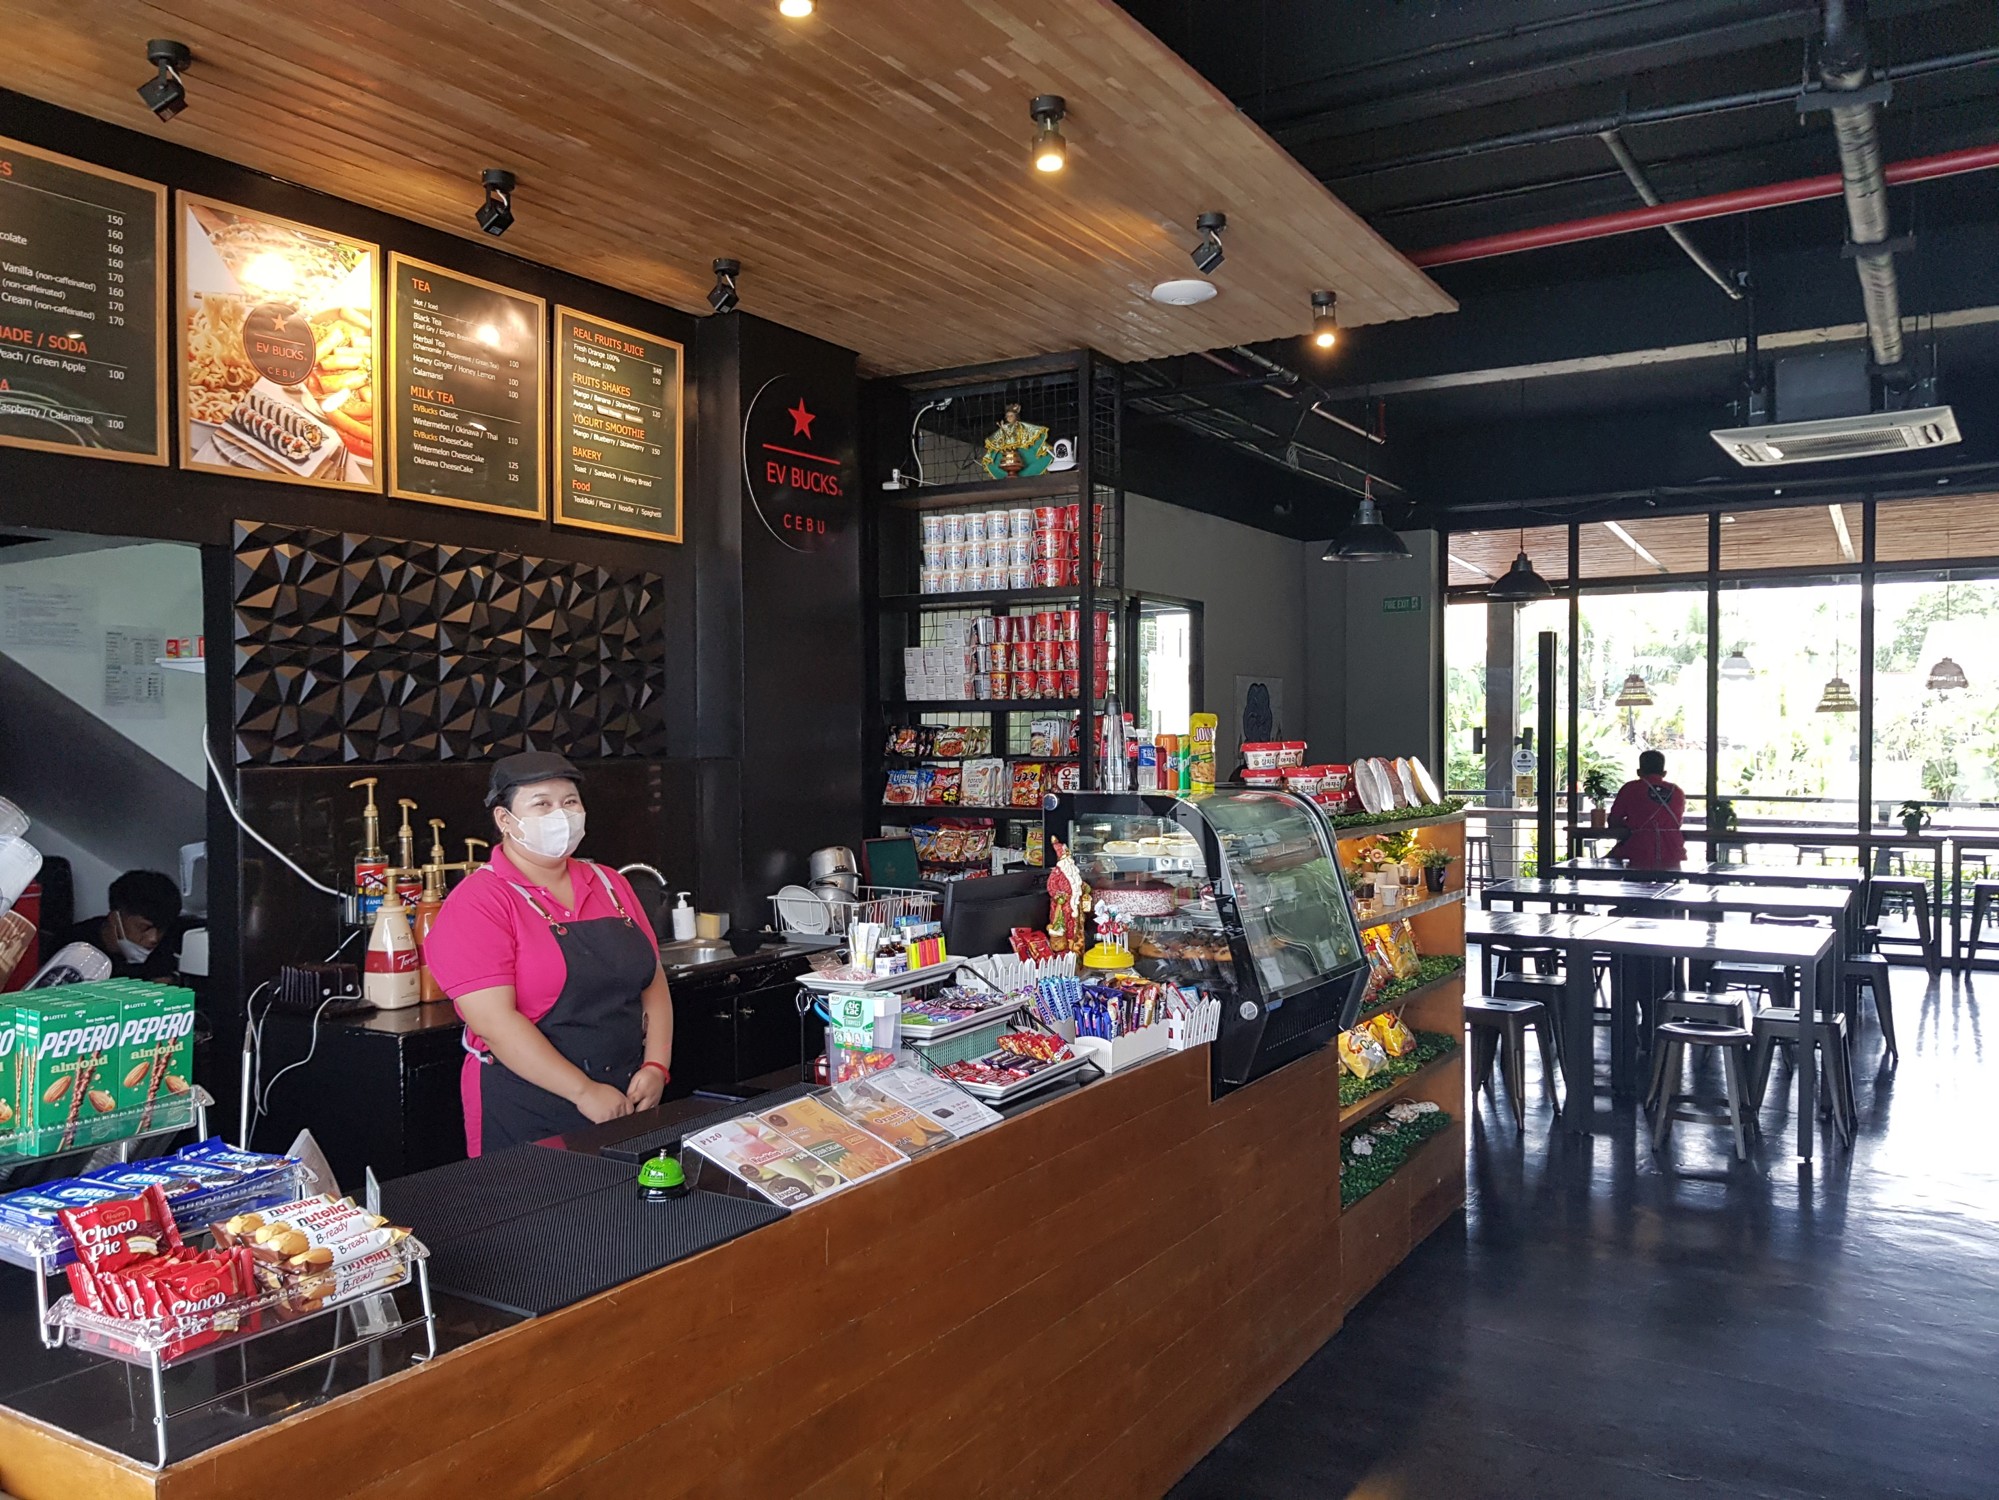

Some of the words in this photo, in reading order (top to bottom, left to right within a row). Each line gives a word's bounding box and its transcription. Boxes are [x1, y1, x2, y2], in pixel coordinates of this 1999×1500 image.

[107, 214, 123, 226] 150
[107, 229, 123, 240] 160
[108, 243, 124, 255] 160
[108, 258, 124, 269] 160
[2, 261, 34, 277] Vanilla
[35, 270, 97, 292] (non-caffeinated)
[108, 272, 124, 284] 170
[2, 278, 66, 300] (non-caffeinated)
[108, 286, 124, 298] 160
[412, 278, 431, 293] TEA
[1, 291, 32, 306] Cream
[34, 300, 95, 320] (non-caffeinated)
[108, 301, 124, 312] 170
[413, 298, 424, 307] Hot
[109, 315, 124, 327] 170
[413, 313, 430, 324] Black
[432, 317, 442, 326] Tea
[48, 335, 88, 354] SODA
[256, 342, 269, 353] EV
[413, 334, 433, 345] Herbal
[435, 339, 446, 348] Tea
[573, 327, 593, 341] REAL
[594, 333, 621, 350] FRUITS
[623, 342, 644, 357] JUICE
[573, 343, 587, 353] Fresh
[587, 347, 605, 359] Orange
[33, 355, 59, 368] Green
[62, 360, 86, 373] Apple
[413, 354, 433, 366] Honey
[434, 358, 453, 372] Ginger
[458, 366, 477, 377] Honey
[477, 369, 496, 380] Lemon
[509, 360, 519, 368] 100
[573, 354, 587, 364] Fresh
[587, 358, 601, 368] Apple
[109, 369, 125, 380] 100
[267, 366, 295, 379] CEBU
[413, 367, 443, 381] Calamansi
[508, 378, 519, 387] 100
[572, 372, 600, 388] FRUITS
[601, 380, 631, 397] SHAKES
[411, 385, 434, 400] MILK
[436, 391, 455, 405] TEA
[508, 391, 519, 399] 100
[573, 389, 590, 400] Mango
[413, 404, 438, 416] EVBucks
[439, 409, 458, 420] Classic
[573, 400, 593, 411] Avocado
[49, 409, 94, 424] Calamansi
[108, 420, 124, 430] 100
[413, 417, 450, 431] Wintermelon
[455, 425, 480, 437] Okinawa
[486, 433, 498, 441] Thai
[572, 413, 604, 428] YOGURT
[605, 422, 645, 439] SMOOTHIE
[413, 430, 438, 441] EVBucks
[439, 435, 473, 448] CheeseCake
[573, 429, 590, 439] Mango
[413, 443, 450, 456] Wintermelon
[451, 450, 484, 463] CheeseCake
[572, 446, 602, 461] BAKERY
[413, 456, 438, 468] Okinawa
[440, 460, 474, 474] CheeseCake
[508, 461, 519, 469] 125
[508, 474, 519, 482] 125
[594, 469, 616, 480] Sandwich
[767, 461, 787, 485] EV
[572, 480, 591, 492] Food
[783, 514, 825, 534] CEBU
[849, 1001, 860, 1010] tic
[1034, 991, 1053, 1025] mentos
[119, 1010, 194, 1047] PEPERO
[37, 1022, 119, 1060] PEPERO
[131, 1041, 184, 1059] almond
[51, 1055, 108, 1073] almond
[873, 1108, 912, 1125] Orange
[168, 1165, 223, 1175] OREO
[119, 1173, 170, 1184] OREO
[60, 1187, 116, 1198] OREO
[77, 1207, 98, 1219] LOTTE
[268, 1197, 322, 1217] nutella
[296, 1203, 349, 1227] nutella
[81, 1219, 138, 1246] Choco
[316, 1220, 348, 1245] B-ready
[89, 1239, 121, 1264] Pie
[338, 1234, 369, 1255] B-ready
[172, 1291, 226, 1317] Choco
